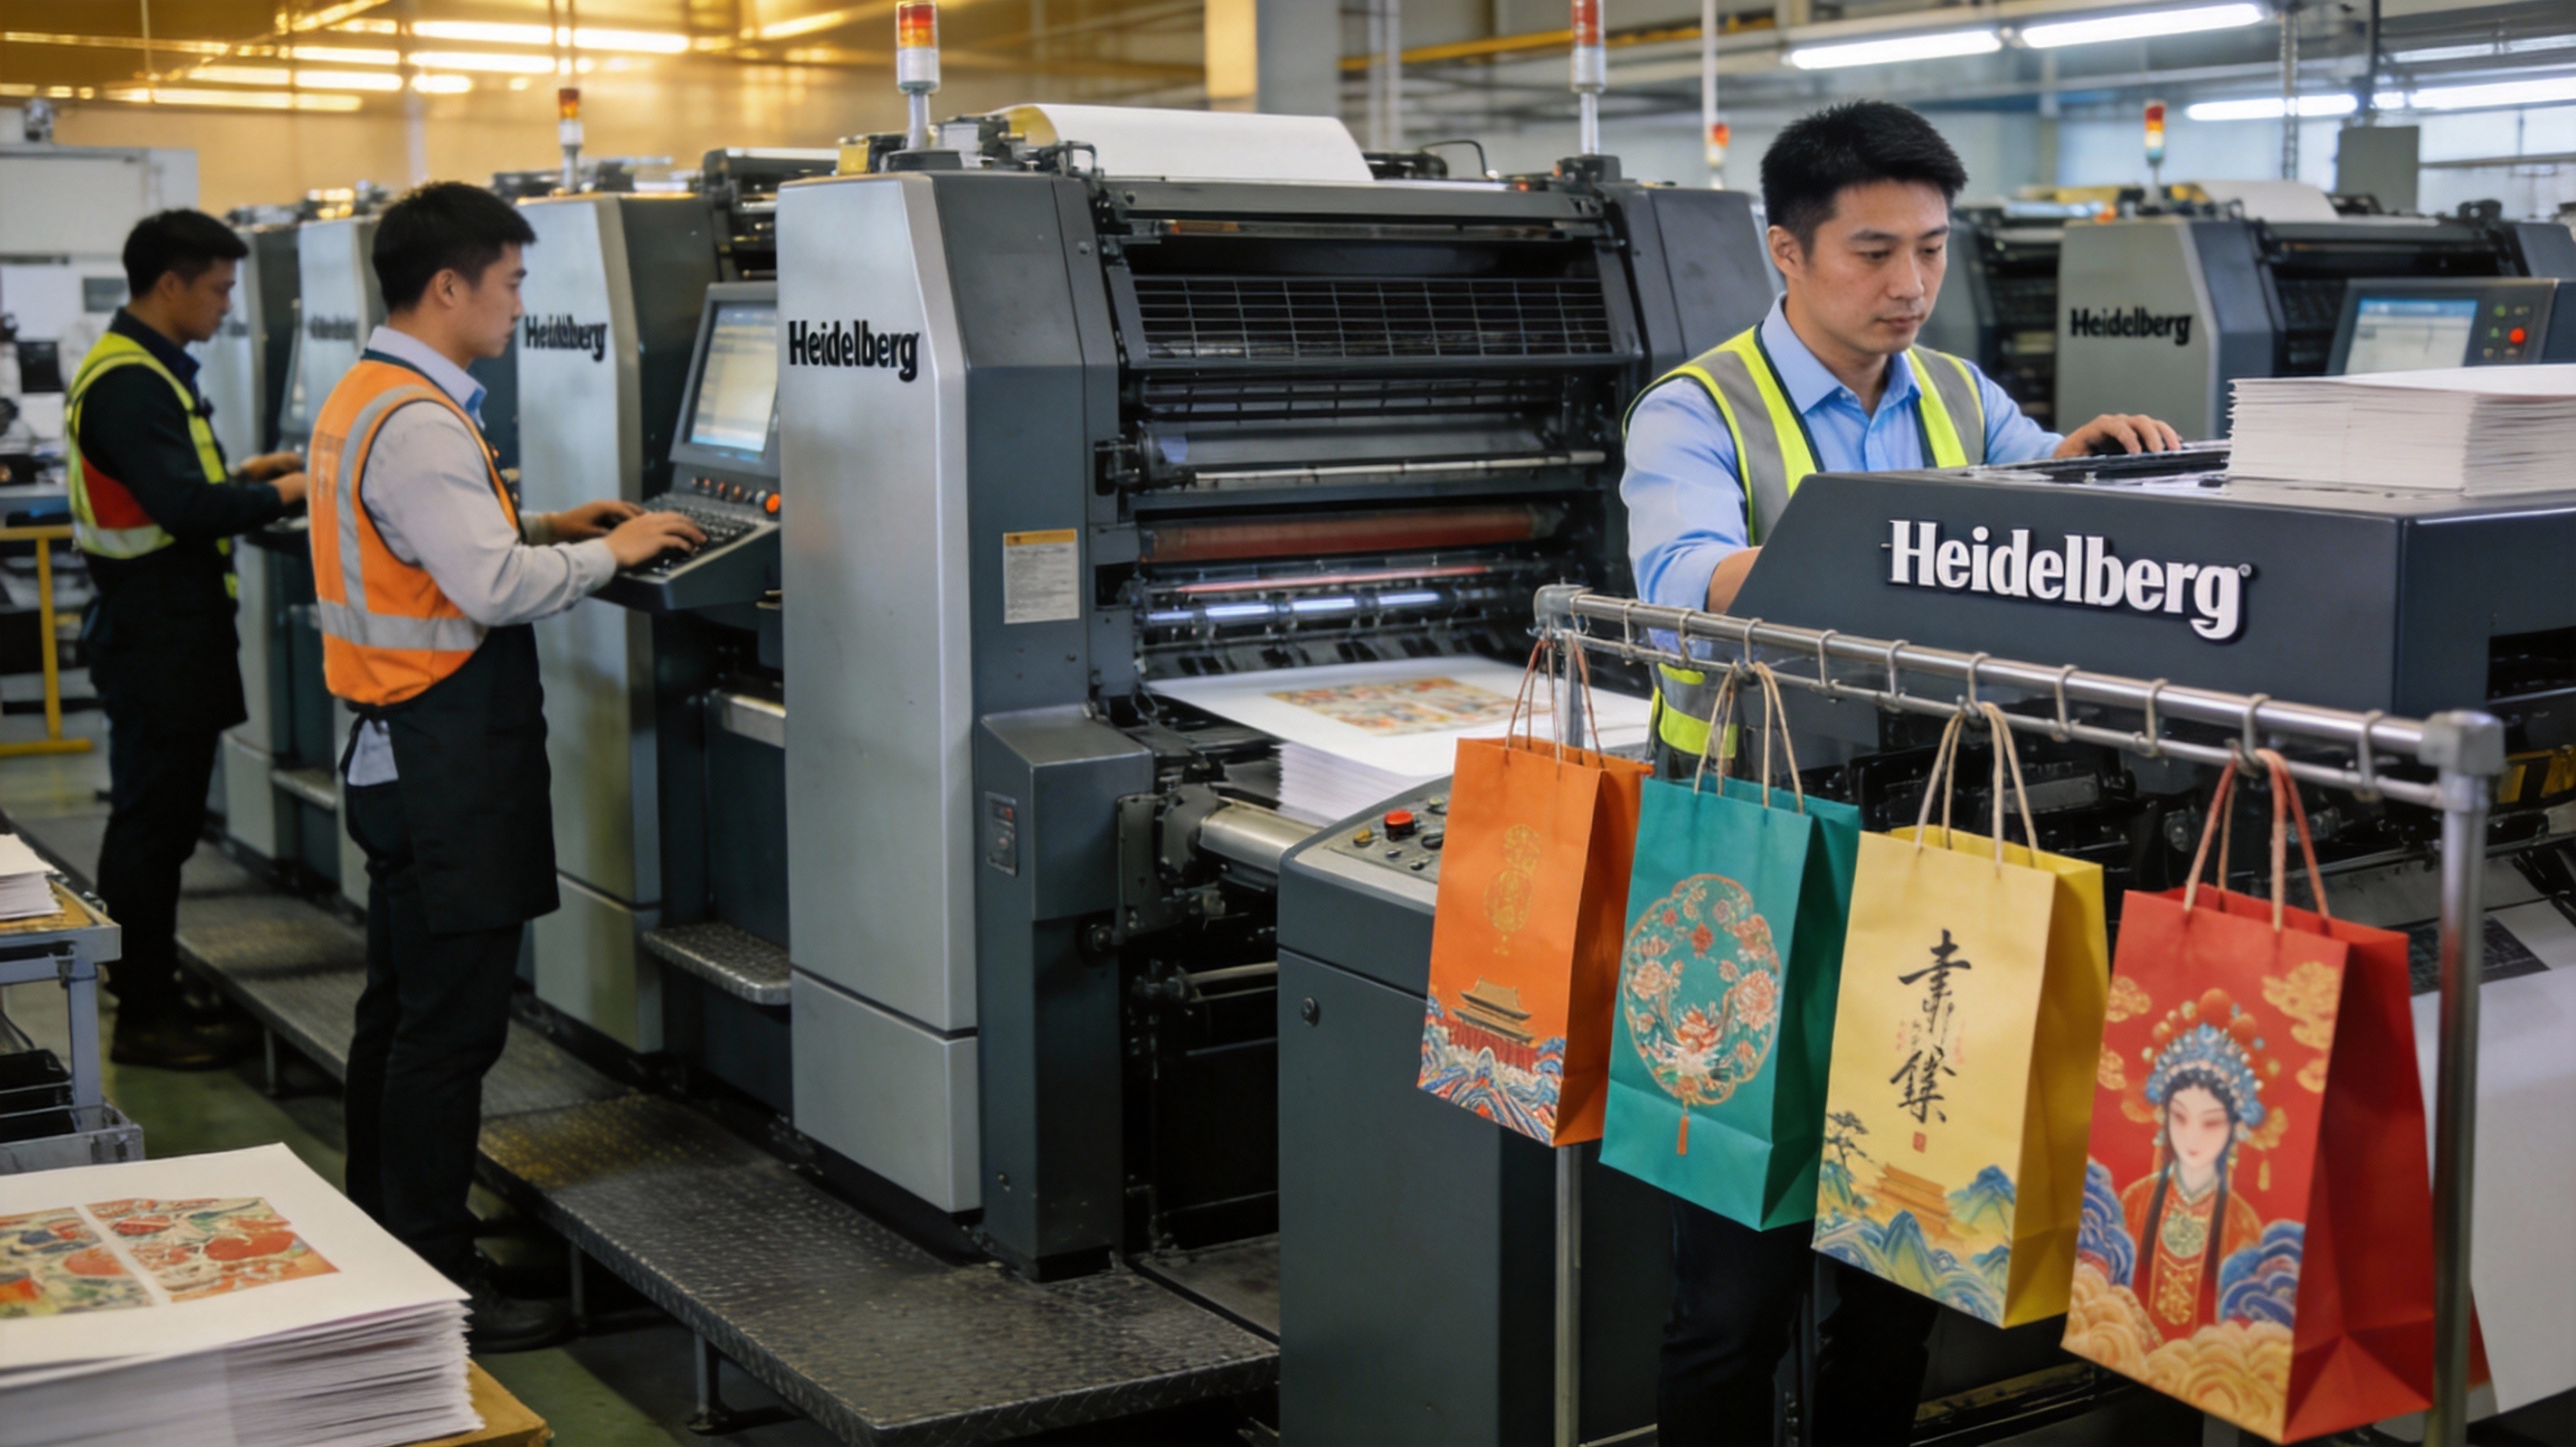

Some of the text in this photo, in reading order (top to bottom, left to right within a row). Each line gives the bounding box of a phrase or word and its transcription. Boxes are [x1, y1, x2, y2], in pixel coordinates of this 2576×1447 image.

[789, 320, 920, 383] Heidelberg
[2070, 306, 2192, 346] Heidelberg
[1889, 520, 2242, 640] Heidelberg
